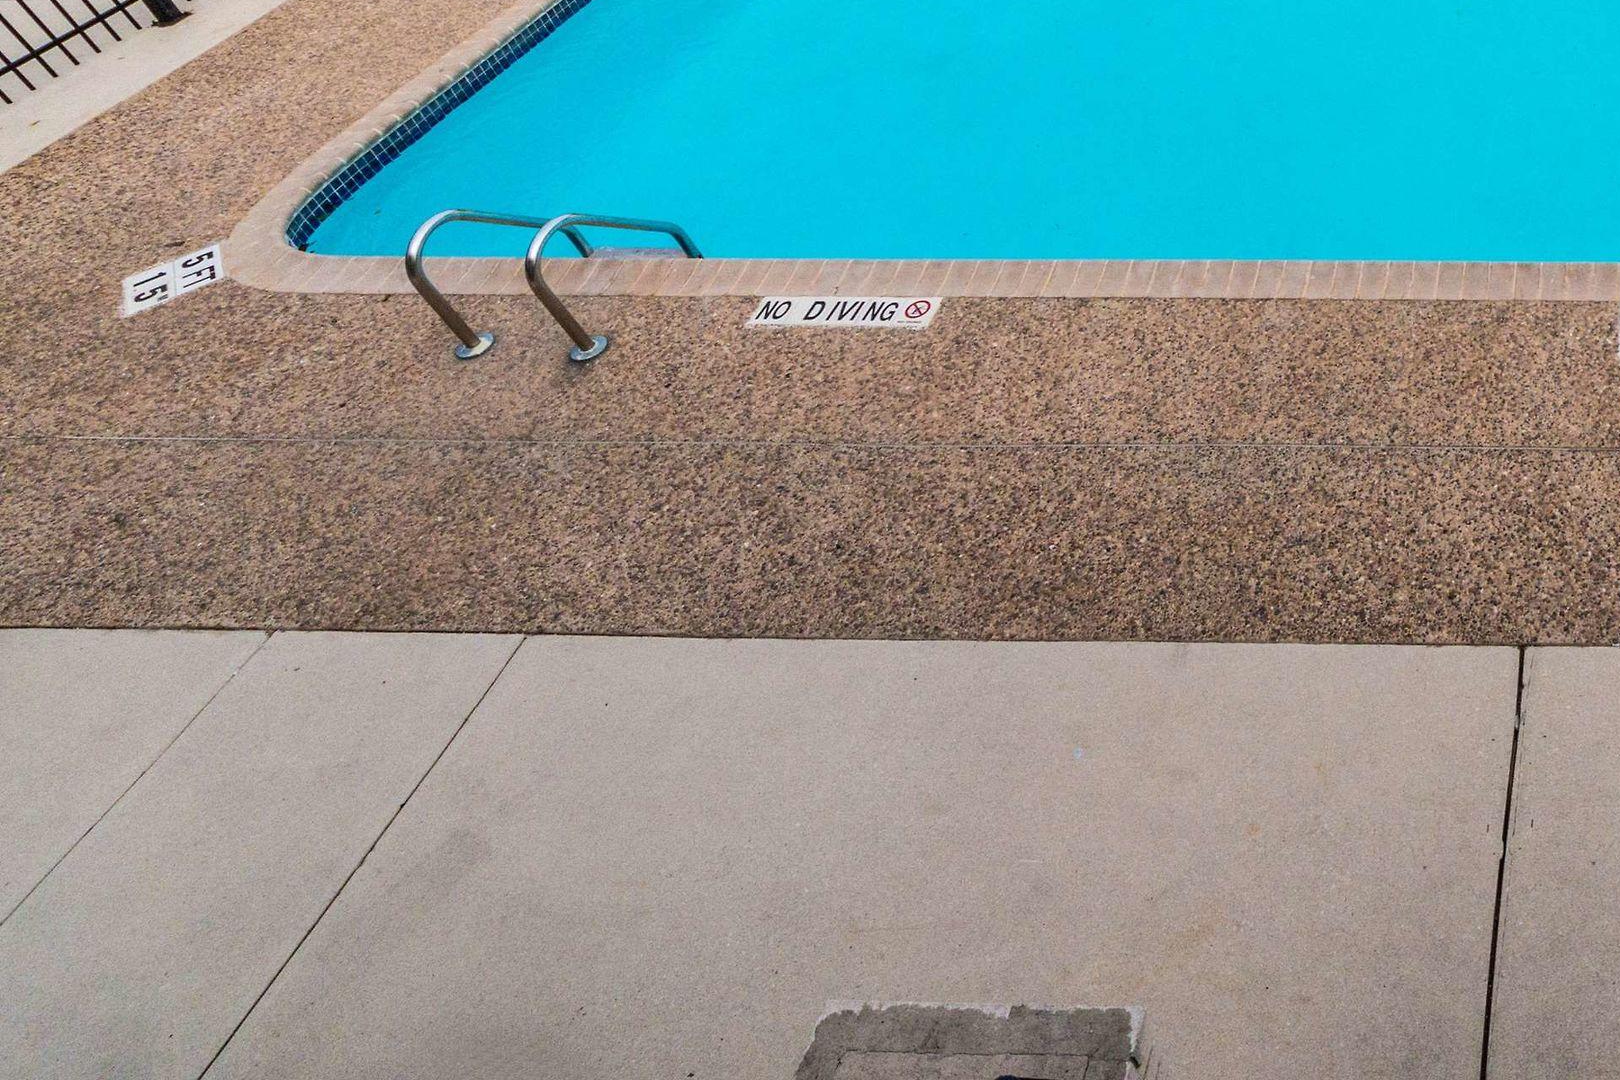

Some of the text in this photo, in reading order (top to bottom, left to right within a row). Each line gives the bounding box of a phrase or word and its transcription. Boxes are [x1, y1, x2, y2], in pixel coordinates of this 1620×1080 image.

[181, 251, 216, 289] 5 FT
[755, 300, 899, 322] NO DIVING
